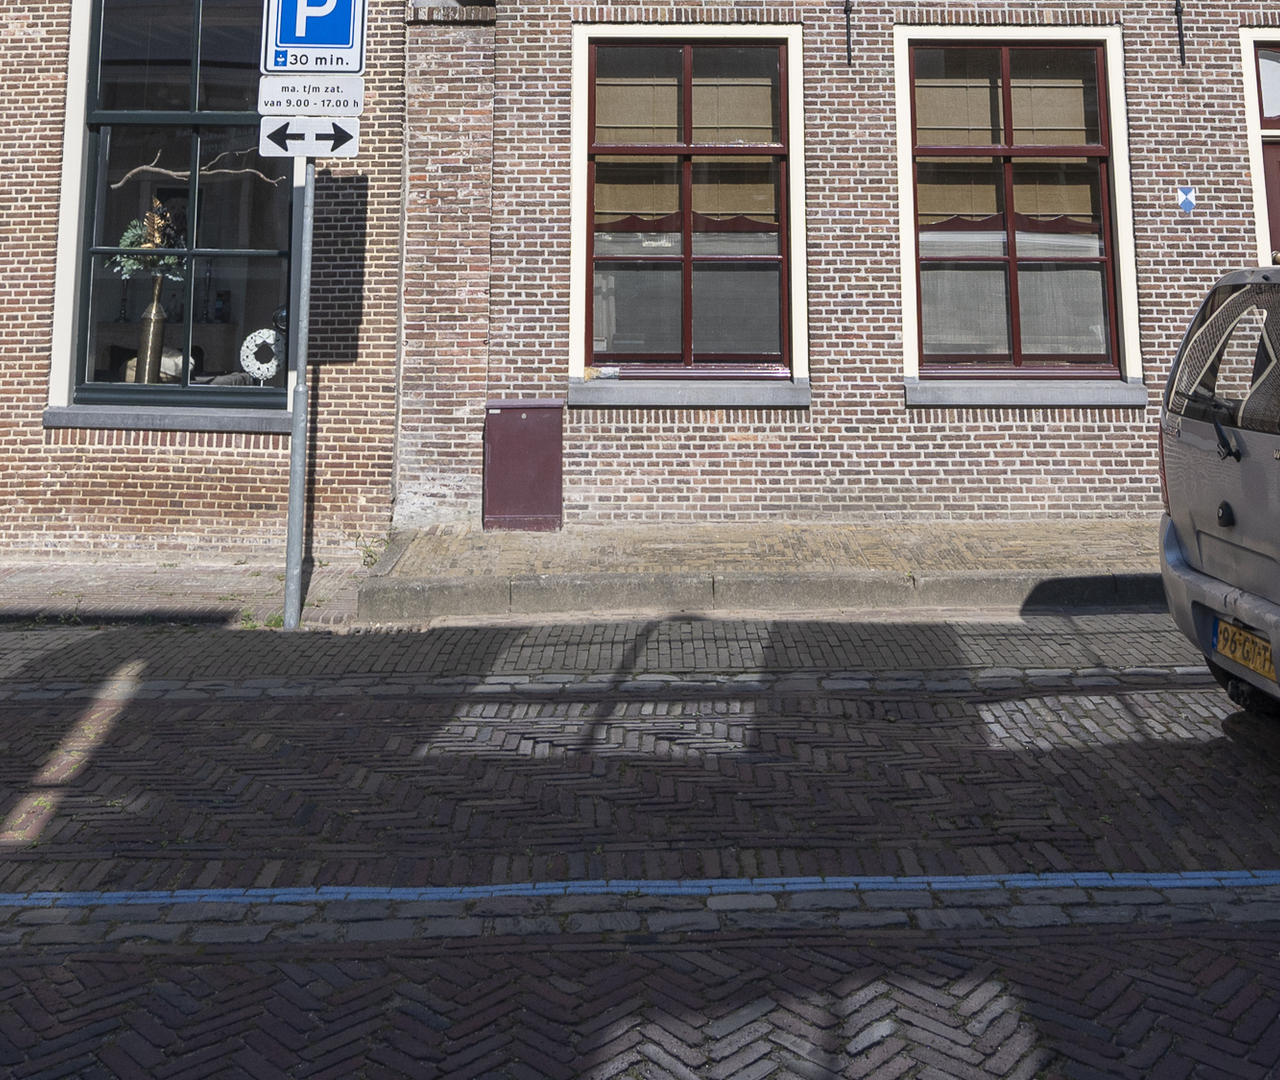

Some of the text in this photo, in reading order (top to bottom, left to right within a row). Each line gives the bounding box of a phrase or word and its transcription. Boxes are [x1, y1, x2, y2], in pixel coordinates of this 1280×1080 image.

[289, 54, 349, 66] 30 min.
[303, 84, 320, 94] t/m
[324, 85, 344, 93] zat.
[285, 99, 310, 107] 9.00
[321, 99, 349, 108] 17.00
[353, 99, 359, 107] h
